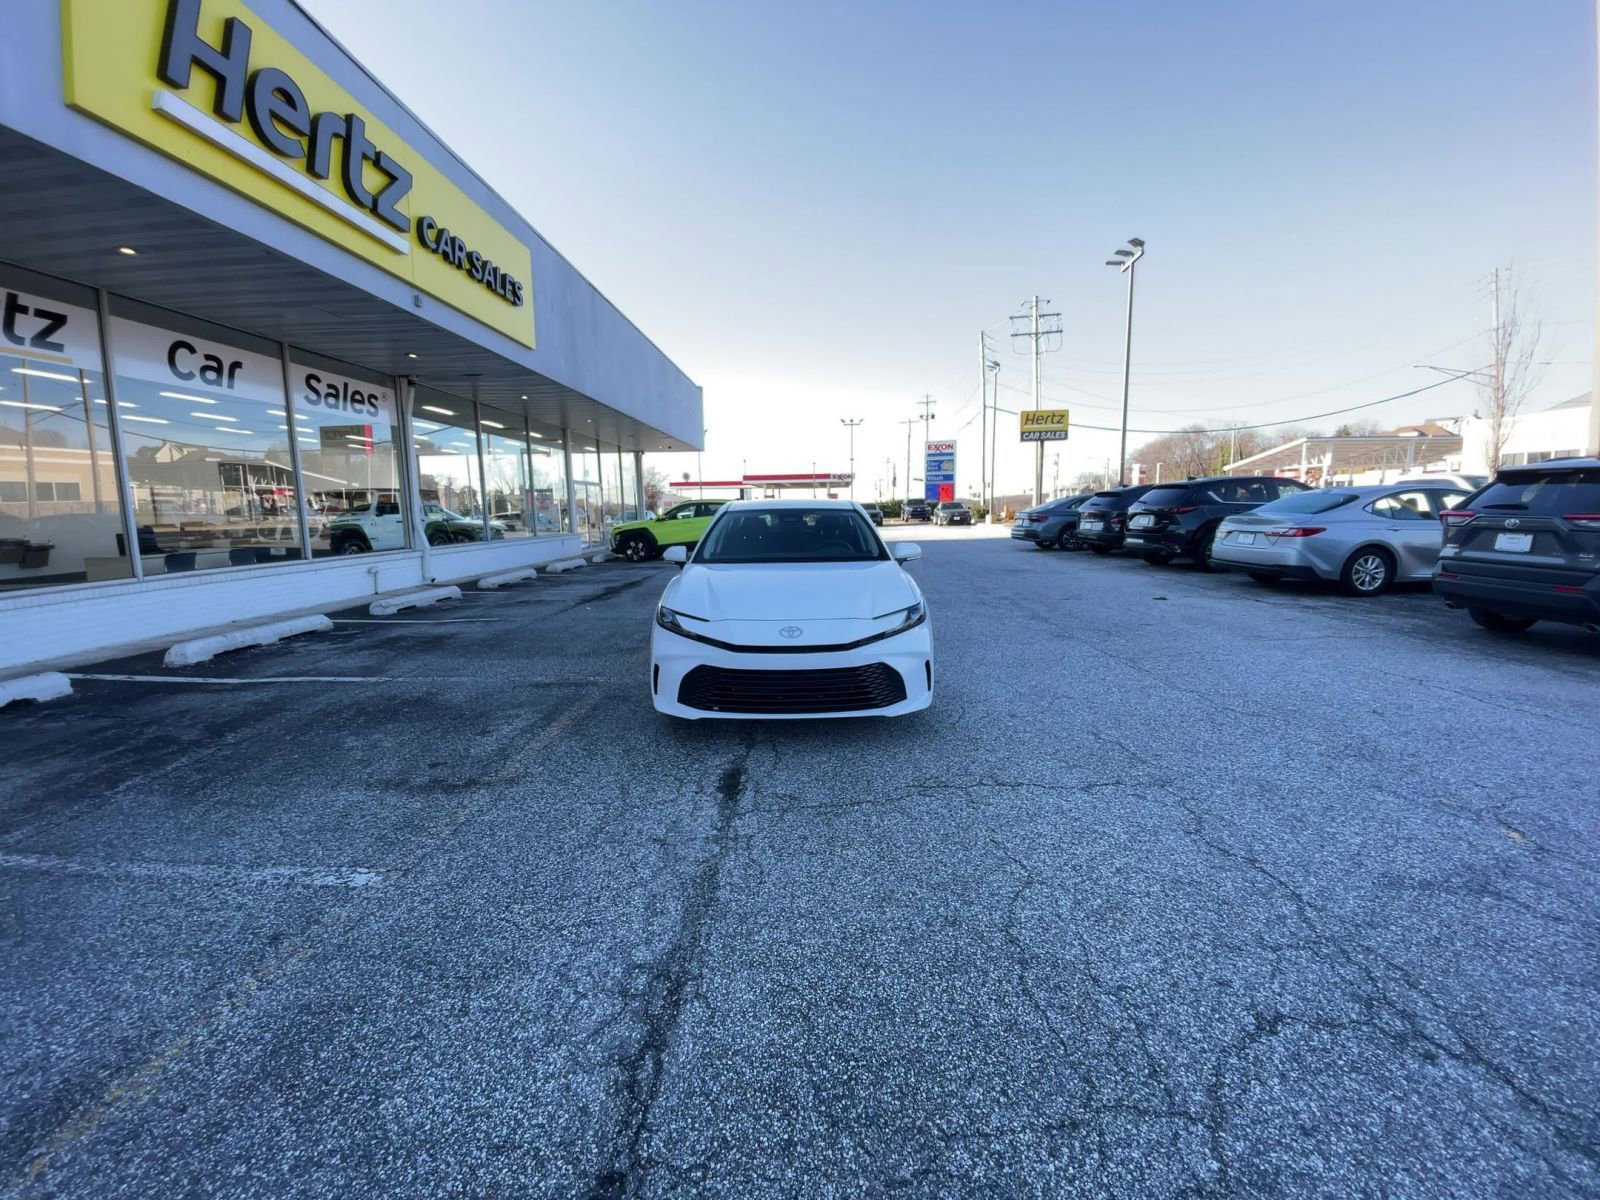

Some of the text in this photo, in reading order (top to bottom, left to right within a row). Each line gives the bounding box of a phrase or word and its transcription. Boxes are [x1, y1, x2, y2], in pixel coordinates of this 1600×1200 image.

[157, 0, 413, 233] Hertz
[417, 216, 523, 306] CAR SALES
[168, 340, 243, 389] Car
[1024, 412, 1066, 425] Hertz
[928, 443, 953, 453] EXXON
[1023, 431, 1066, 440] CAR SALES
